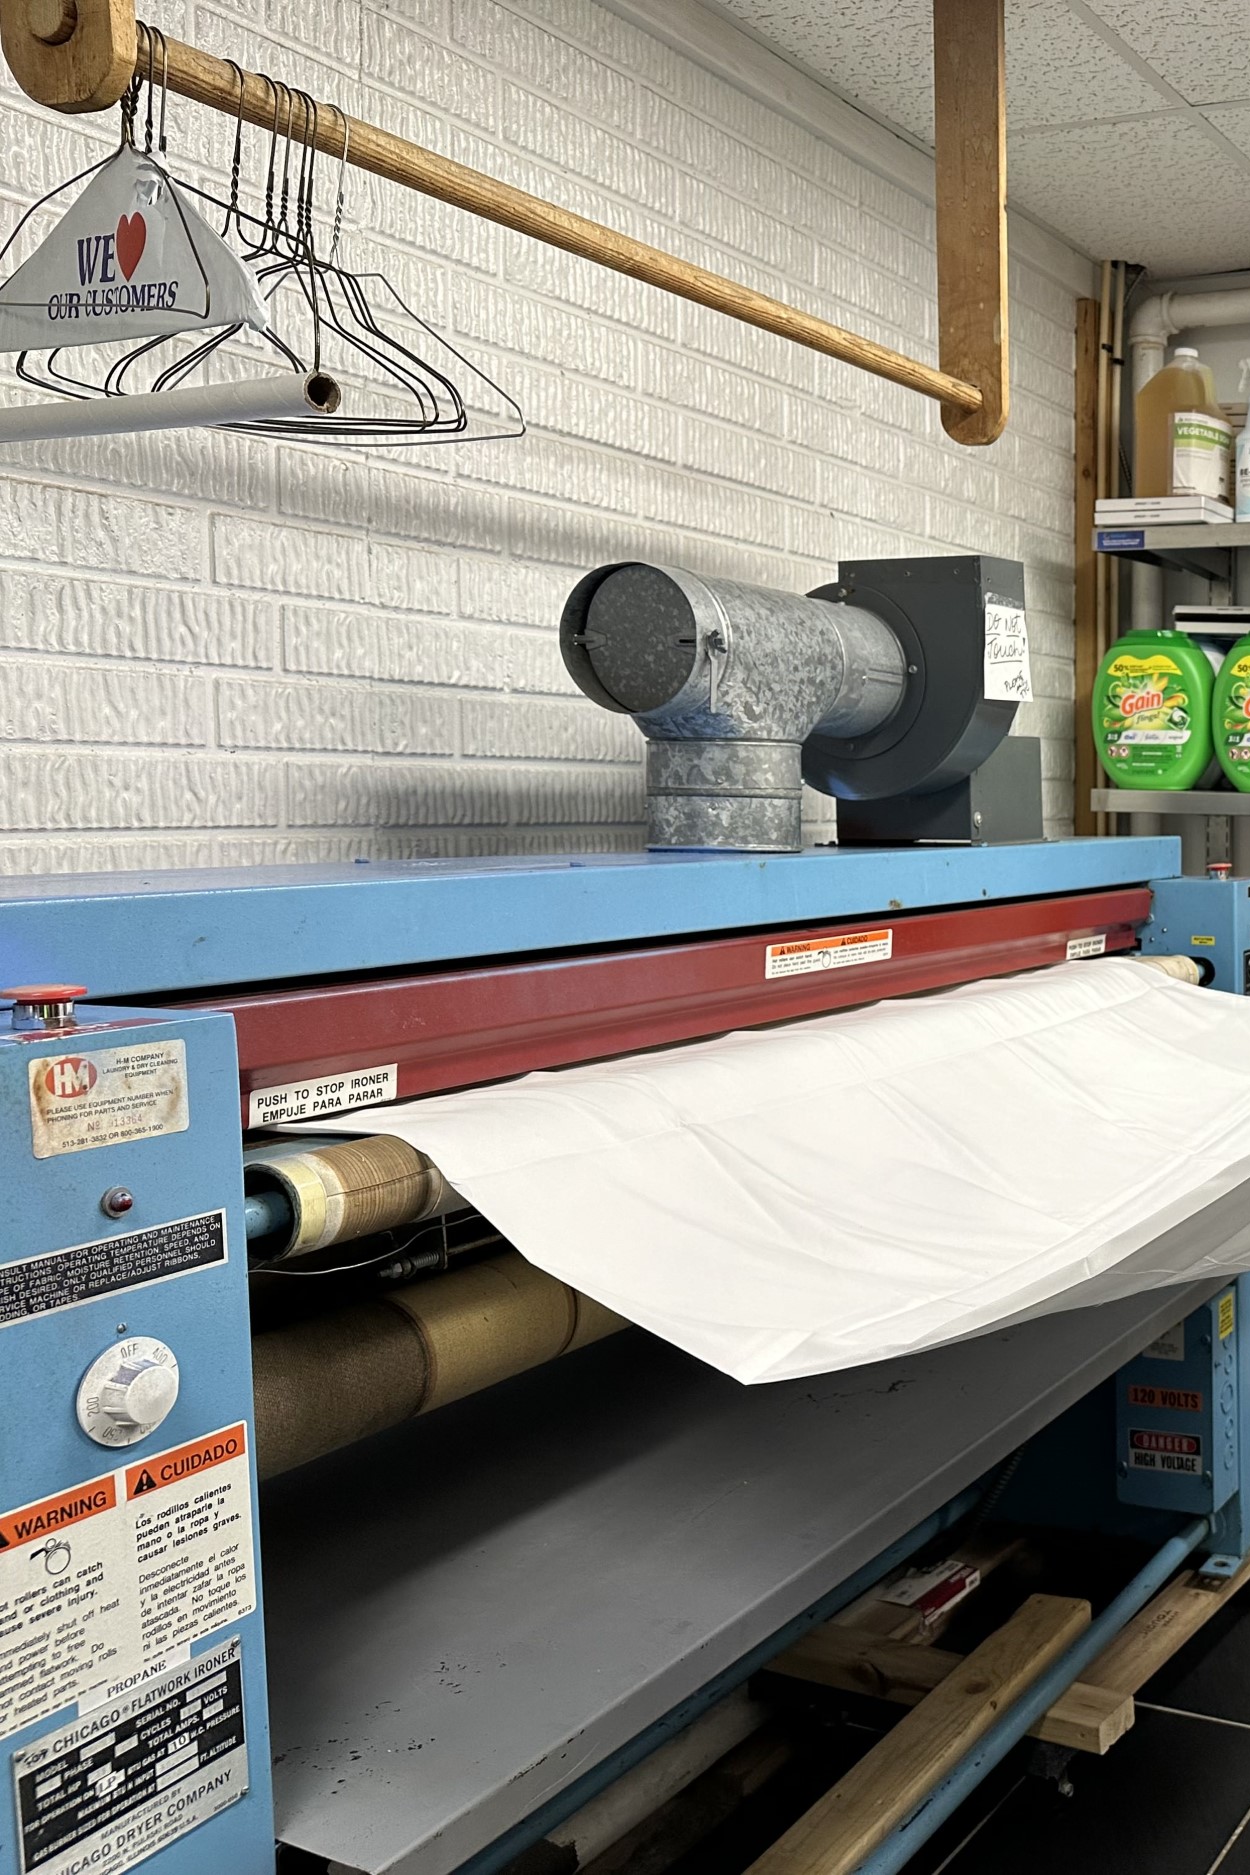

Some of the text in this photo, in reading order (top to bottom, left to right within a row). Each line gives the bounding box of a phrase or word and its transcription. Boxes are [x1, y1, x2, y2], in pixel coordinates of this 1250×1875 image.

[77, 233, 115, 286] WE
[48, 281, 179, 320] OUR CUSTOMERS
[1177, 427, 1219, 441] VEGETABLE
[1121, 691, 1162, 716] Gain
[102, 1058, 178, 1075] LAUNDRY CLEANING
[116, 1052, 164, 1065] H-M COMPANY
[124, 1068, 157, 1079] EQUIPMENT
[53, 1060, 90, 1097] HM
[257, 1072, 389, 1109] PUSH TO STOP IRONER
[88, 1092, 154, 1109] EQUIPMENT NUMBER
[94, 1099, 157, 1116] PARTS SERVICE
[262, 1087, 383, 1123] EMPUJE PARA PARAR
[31, 1215, 215, 1270] MANUAL FOR OPERATING AND MAINTENANCE
[58, 1221, 221, 1271] OPERATING TEMPERATURE DEPENDS ON
[67, 1233, 210, 1277] MOISTURE AND
[63, 1239, 216, 1287] ONLY QUALIFIED PERSONNEL SHOULD
[29, 1289, 70, 1306] MACHINE
[120, 1343, 140, 1358] OFF
[86, 1396, 100, 1418] 200
[1132, 1387, 1198, 1409] 120 VOLTS
[160, 1438, 237, 1481] CUIDADO
[1142, 1433, 1189, 1452] DANGER
[1134, 1452, 1197, 1472] HIGH VOLTAGE
[14, 1490, 107, 1539] WARNING
[135, 1483, 232, 1530] Los rodillos calientes
[136, 1502, 213, 1542] pueden atraparle
[137, 1515, 209, 1552] mano ropa
[137, 1512, 242, 1563] causar lesiones graves.
[14, 1561, 103, 1606] rollers can catch
[139, 1543, 240, 1595] inmediatamente calor
[139, 1555, 189, 1584] Desconecte
[156, 1563, 246, 1610] intentar zafar ropa
[163, 1556, 236, 1595] electricidad antes
[40, 1572, 104, 1608] clothing and
[99, 1598, 120, 1613] heat
[191, 1581, 231, 1605] No toque
[28, 1604, 62, 1624] severe
[142, 1620, 172, 1641] rodillos
[192, 1588, 237, 1616] movimiento
[172, 1619, 199, 1638] piezas
[91, 1642, 105, 1654] Do
[106, 1660, 167, 1698] PROPANE
[52, 1709, 120, 1753] CHICAGO
[131, 1671, 191, 1713] FLATWORK
[194, 1648, 236, 1679] IRONER
[135, 1707, 166, 1728] SERIAL
[140, 1685, 228, 1740] CYCLES VOLTS
[147, 1728, 173, 1749] TOTAL
[172, 1733, 187, 1750] 10
[206, 1704, 240, 1730] PRESSURE
[101, 1794, 170, 1840] MANUFACTURED
[116, 1812, 163, 1849] DRYER
[167, 1768, 232, 1817] COMPANY
